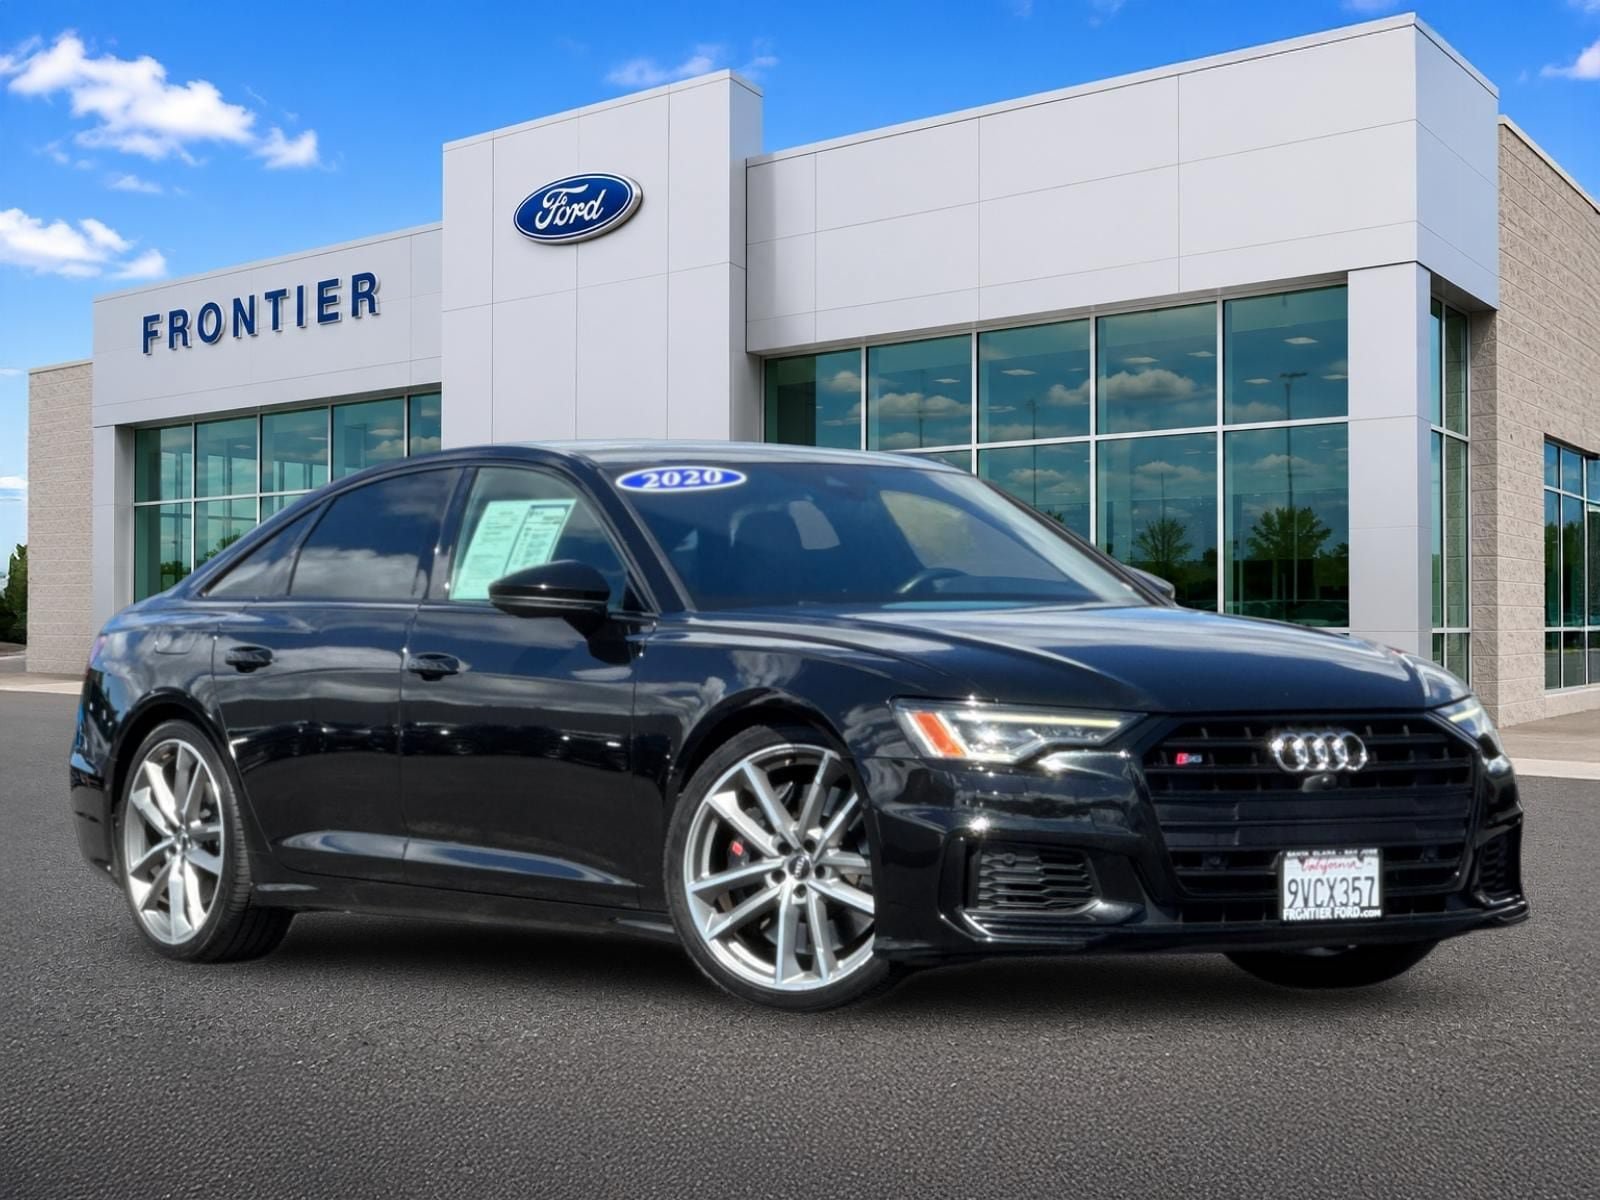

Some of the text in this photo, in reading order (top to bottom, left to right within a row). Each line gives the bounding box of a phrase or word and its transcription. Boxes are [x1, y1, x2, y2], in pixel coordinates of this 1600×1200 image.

[534, 184, 608, 230] Ford
[142, 271, 381, 356] FRONTIER
[640, 469, 723, 489] 2020
[1287, 876, 1375, 908] 9VCX357
[1283, 907, 1333, 920] FRONTIER
